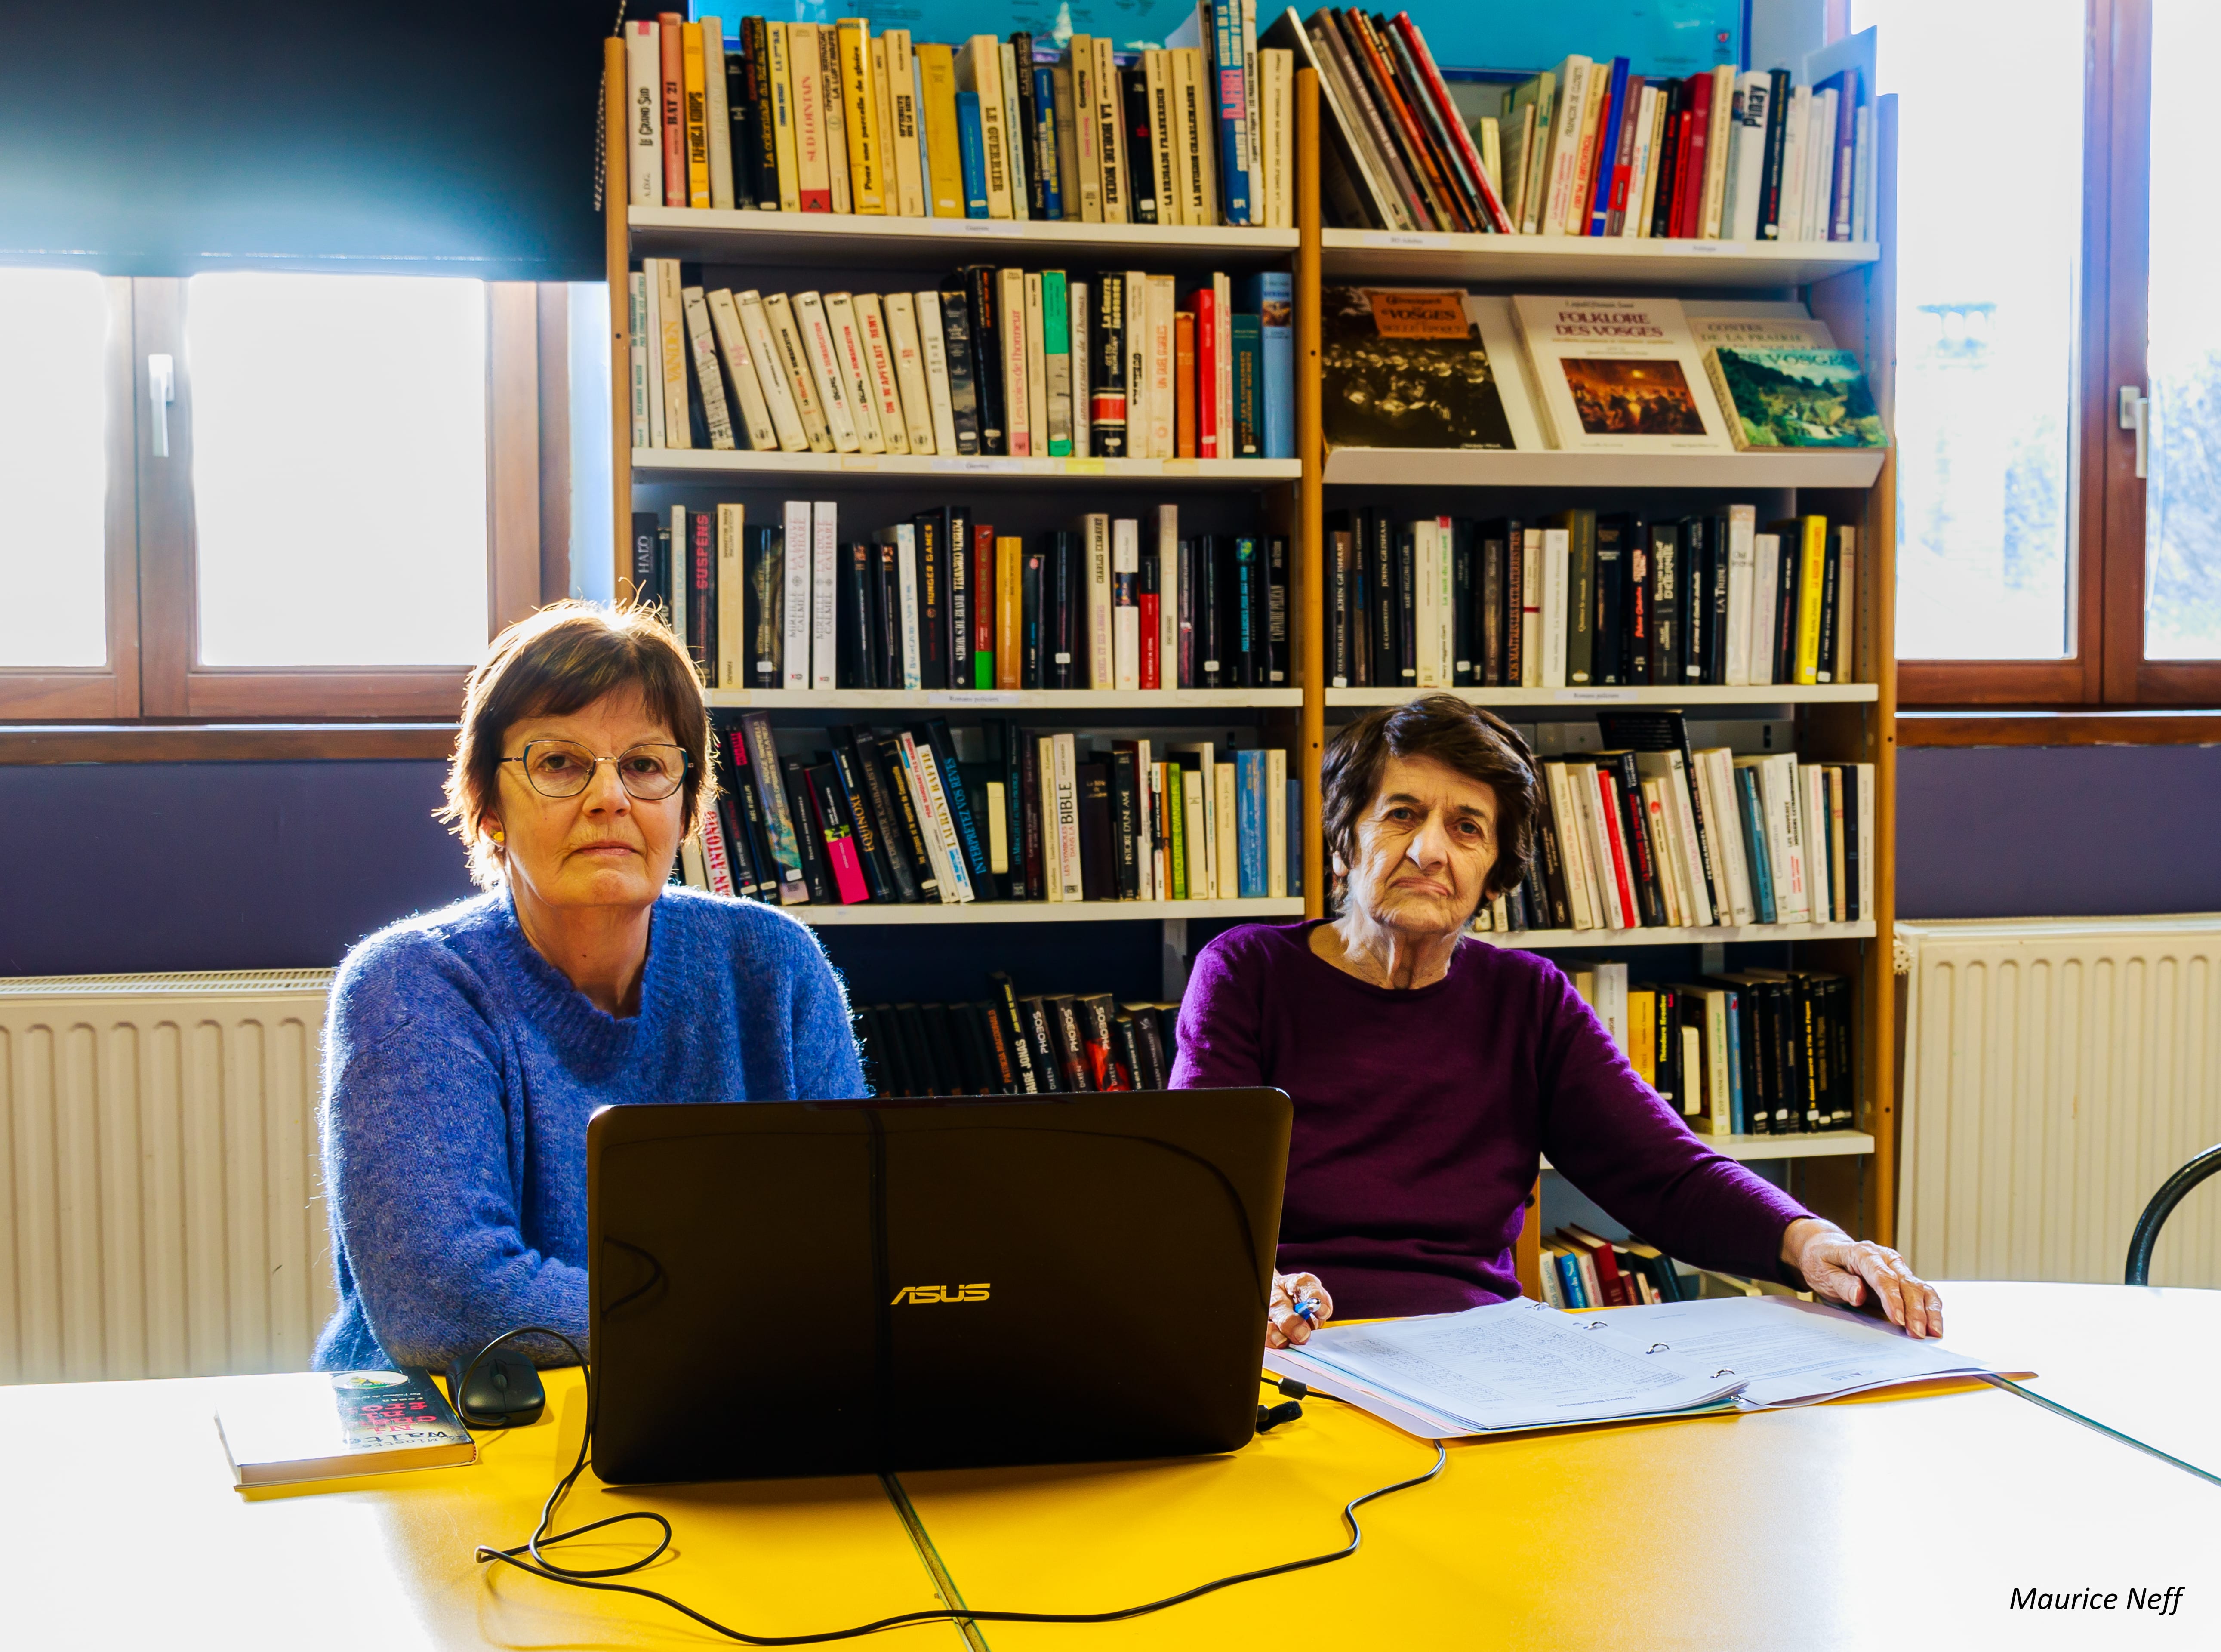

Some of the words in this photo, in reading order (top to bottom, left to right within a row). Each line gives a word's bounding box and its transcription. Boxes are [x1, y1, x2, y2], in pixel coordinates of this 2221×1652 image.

[1059, 782, 1073, 824] BIBLE
[1015, 1039, 1031, 1069] JONAS
[890, 1283, 990, 1305] ASUS
